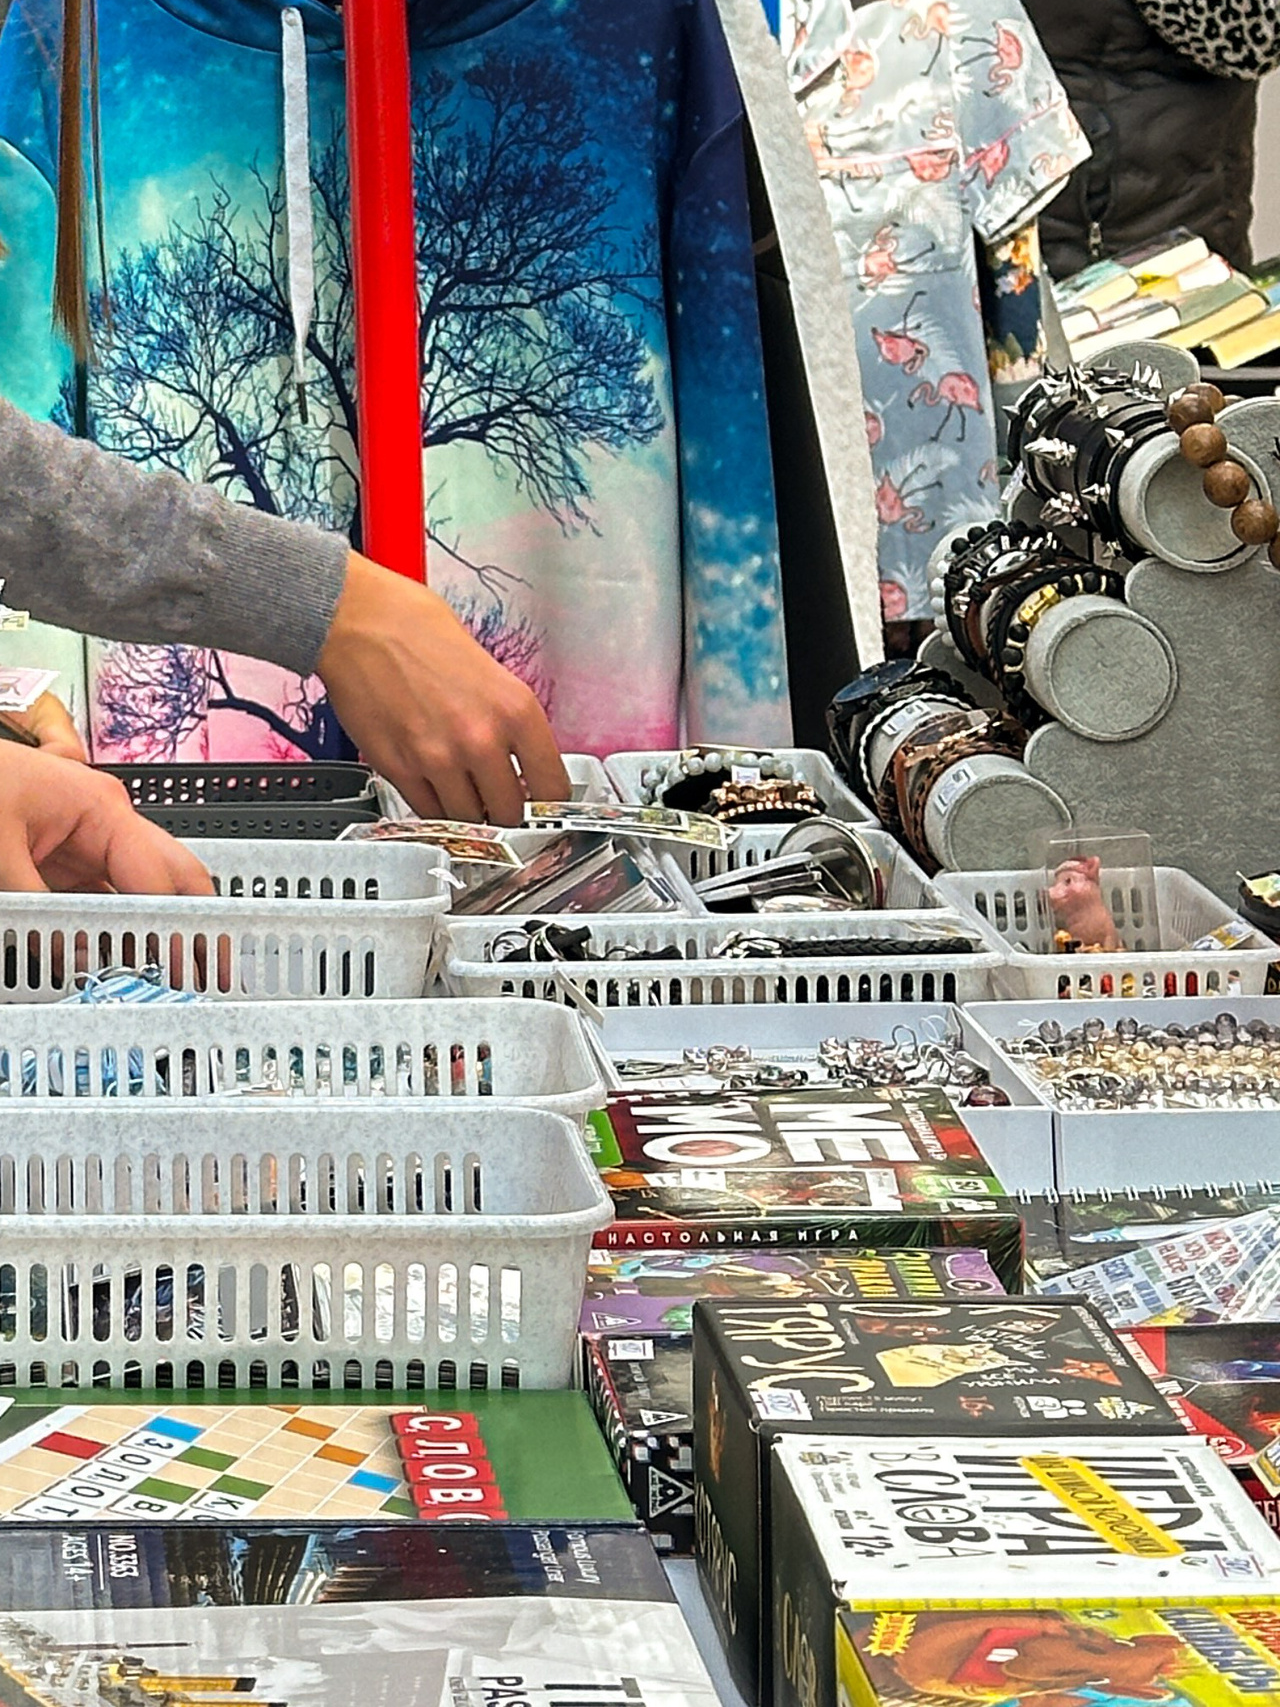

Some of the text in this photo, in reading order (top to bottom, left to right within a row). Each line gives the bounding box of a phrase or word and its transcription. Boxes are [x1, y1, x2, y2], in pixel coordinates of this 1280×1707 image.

[607, 1228, 860, 1248] НАСТОЛЬНАЯ ИГРА
[953, 1454, 1228, 1556] ИГРА
[62, 1532, 89, 1560] AGES
[840, 1535, 894, 1558] 12+
